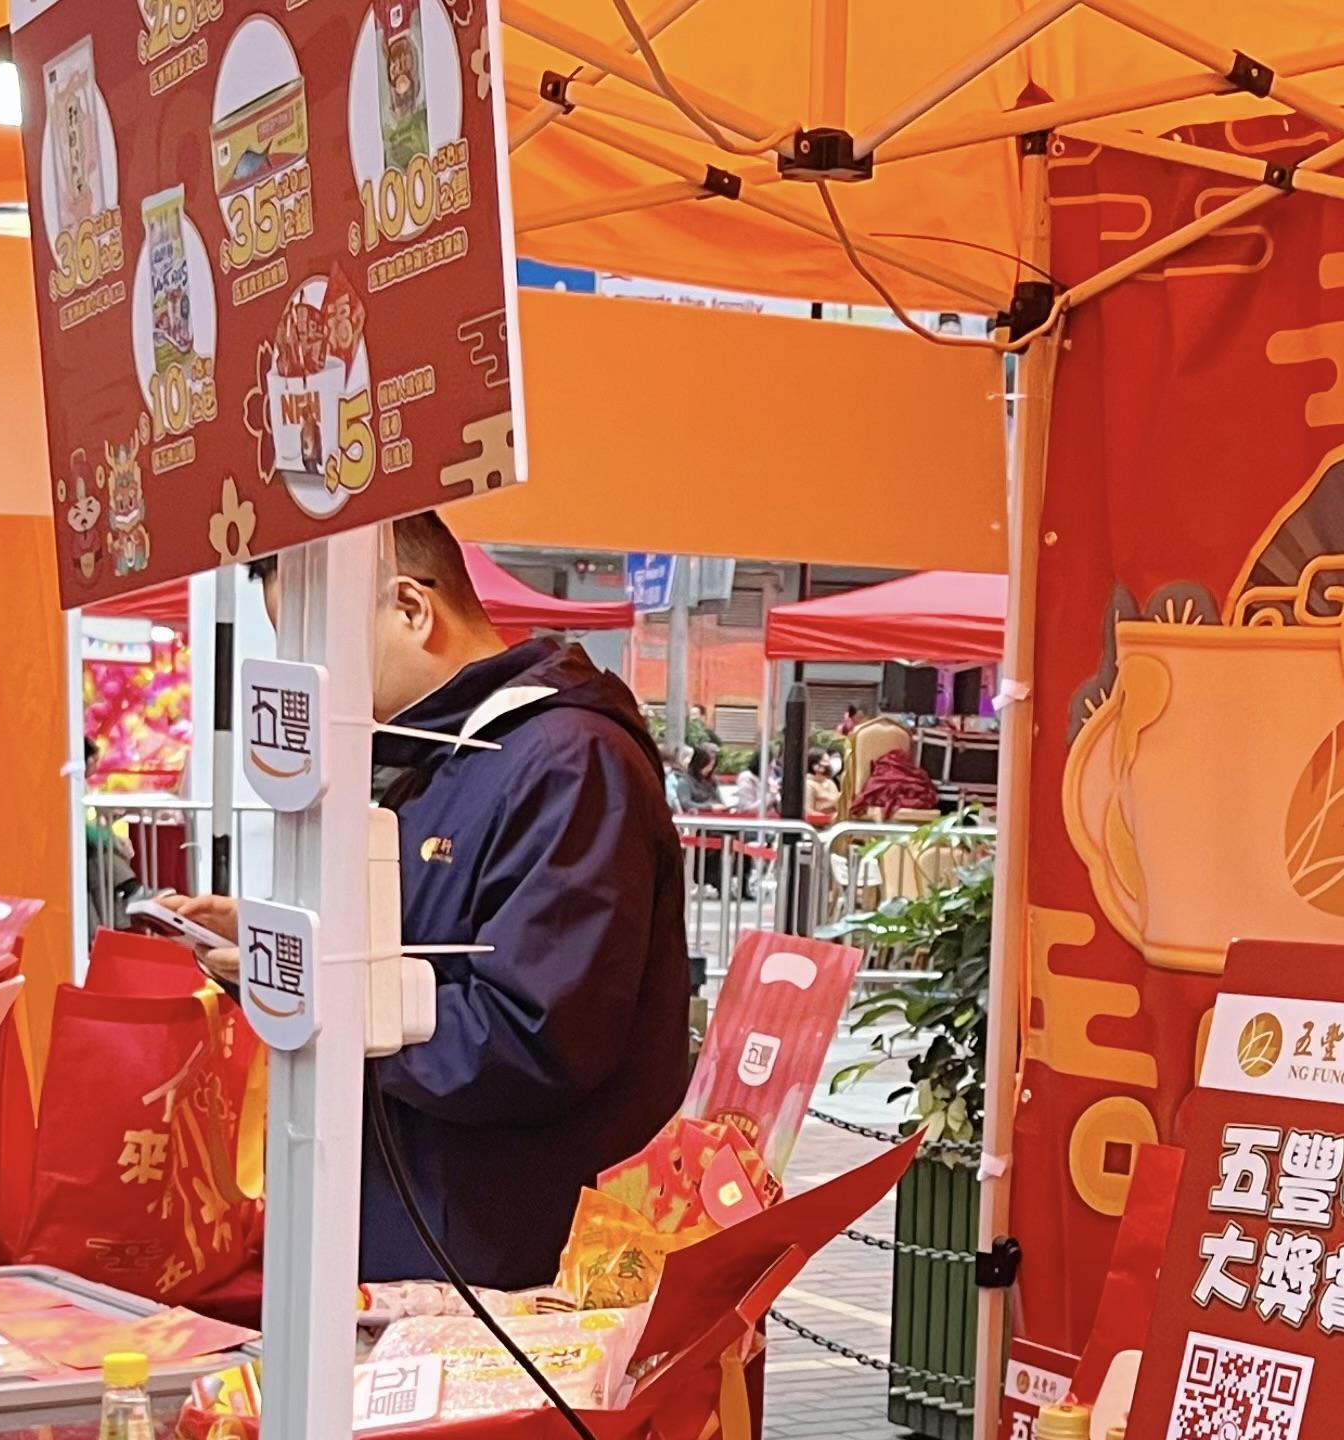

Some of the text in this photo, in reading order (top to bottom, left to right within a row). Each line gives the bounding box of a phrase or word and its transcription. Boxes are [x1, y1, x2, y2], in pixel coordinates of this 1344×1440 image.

[348, 153, 433, 255] $100
[325, 389, 377, 495] $5
[251, 684, 311, 755] 五豐
[249, 924, 305, 998] 五豐
[1288, 1064, 1309, 1084] NG
